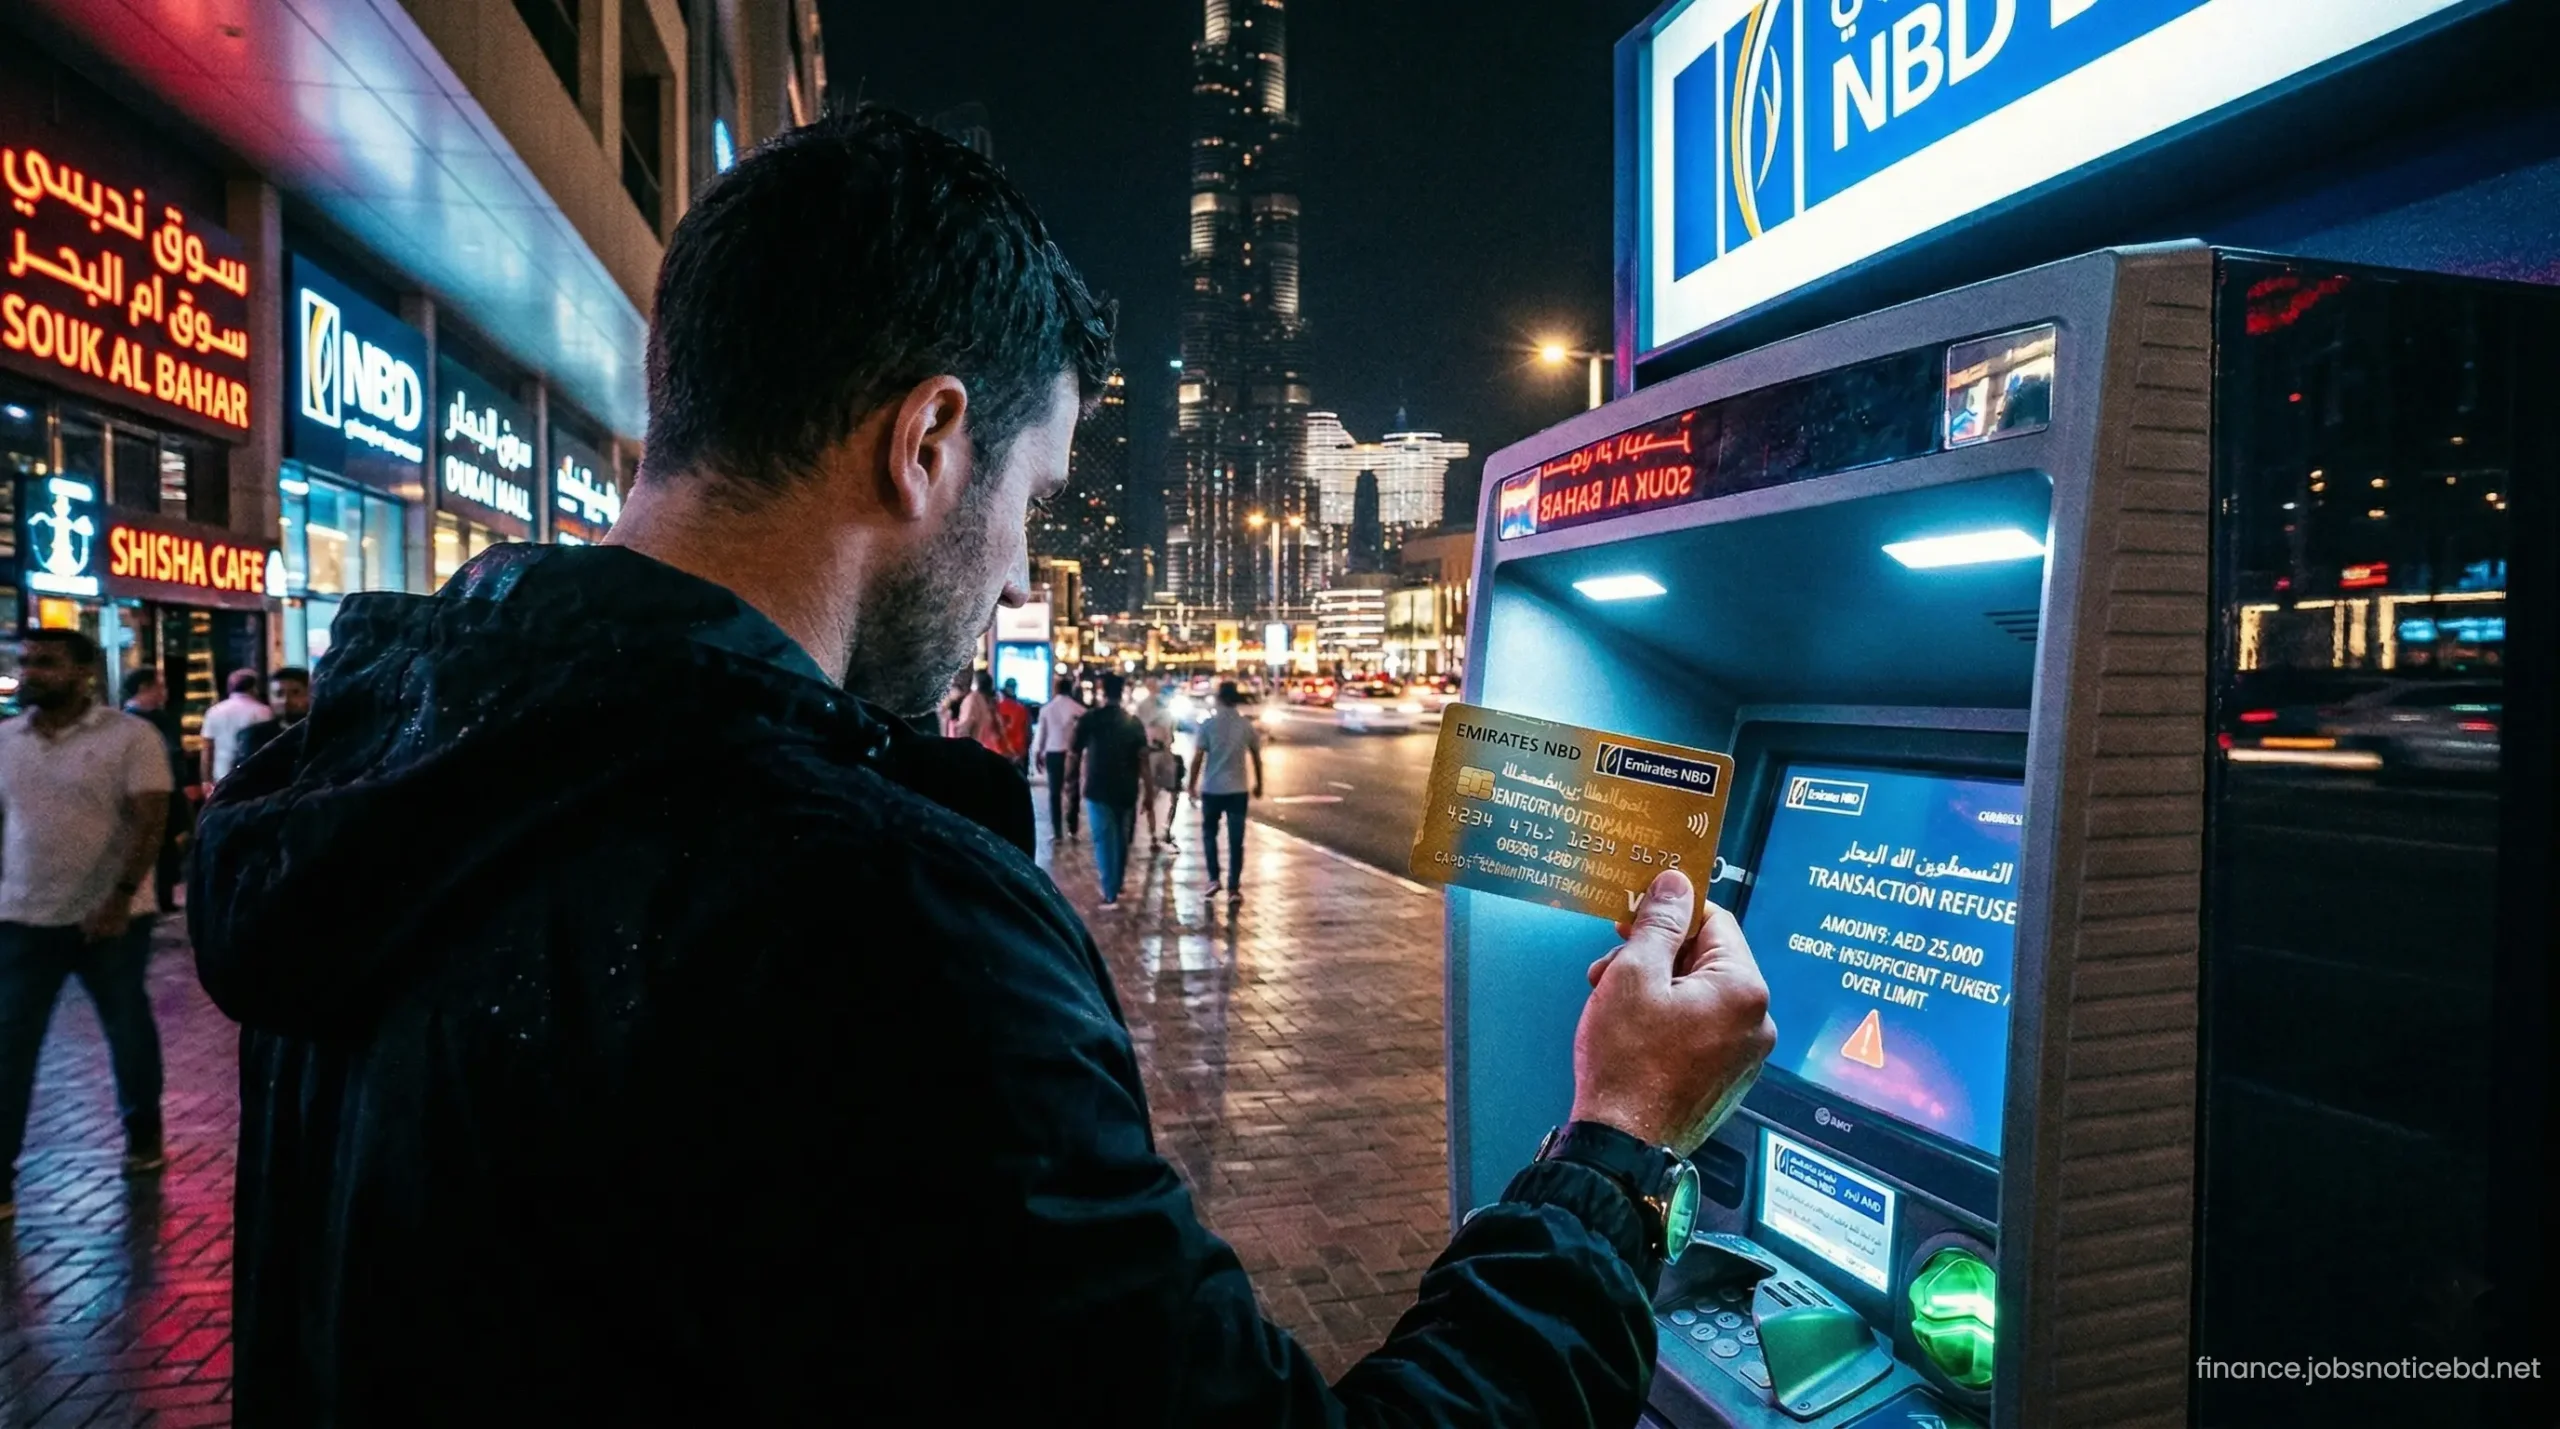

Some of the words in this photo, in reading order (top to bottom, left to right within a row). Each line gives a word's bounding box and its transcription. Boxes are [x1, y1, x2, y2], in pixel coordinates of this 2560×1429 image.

[1833, 0, 2017, 152] NBD
[153, 206, 248, 297] سوق
[168, 289, 248, 360] سوق
[2, 293, 105, 378] SOUK
[108, 336, 151, 394] AL
[155, 352, 249, 429] BAHAR
[343, 331, 422, 432] NBD
[110, 526, 209, 588] SHISHA
[210, 543, 265, 594] CAFE
[1456, 723, 1539, 752] EMIRATES
[1543, 741, 1582, 761] NBD
[1624, 756, 1679, 780] Emirates
[1680, 768, 1712, 785] NBD
[1447, 804, 1493, 828] 4234
[1566, 831, 1617, 855] 1234
[1807, 866, 1937, 910] TRANSACTION
[1891, 930, 1926, 953] AED
[1927, 937, 1985, 967] 25,000
[1841, 971, 1882, 997] OVER
